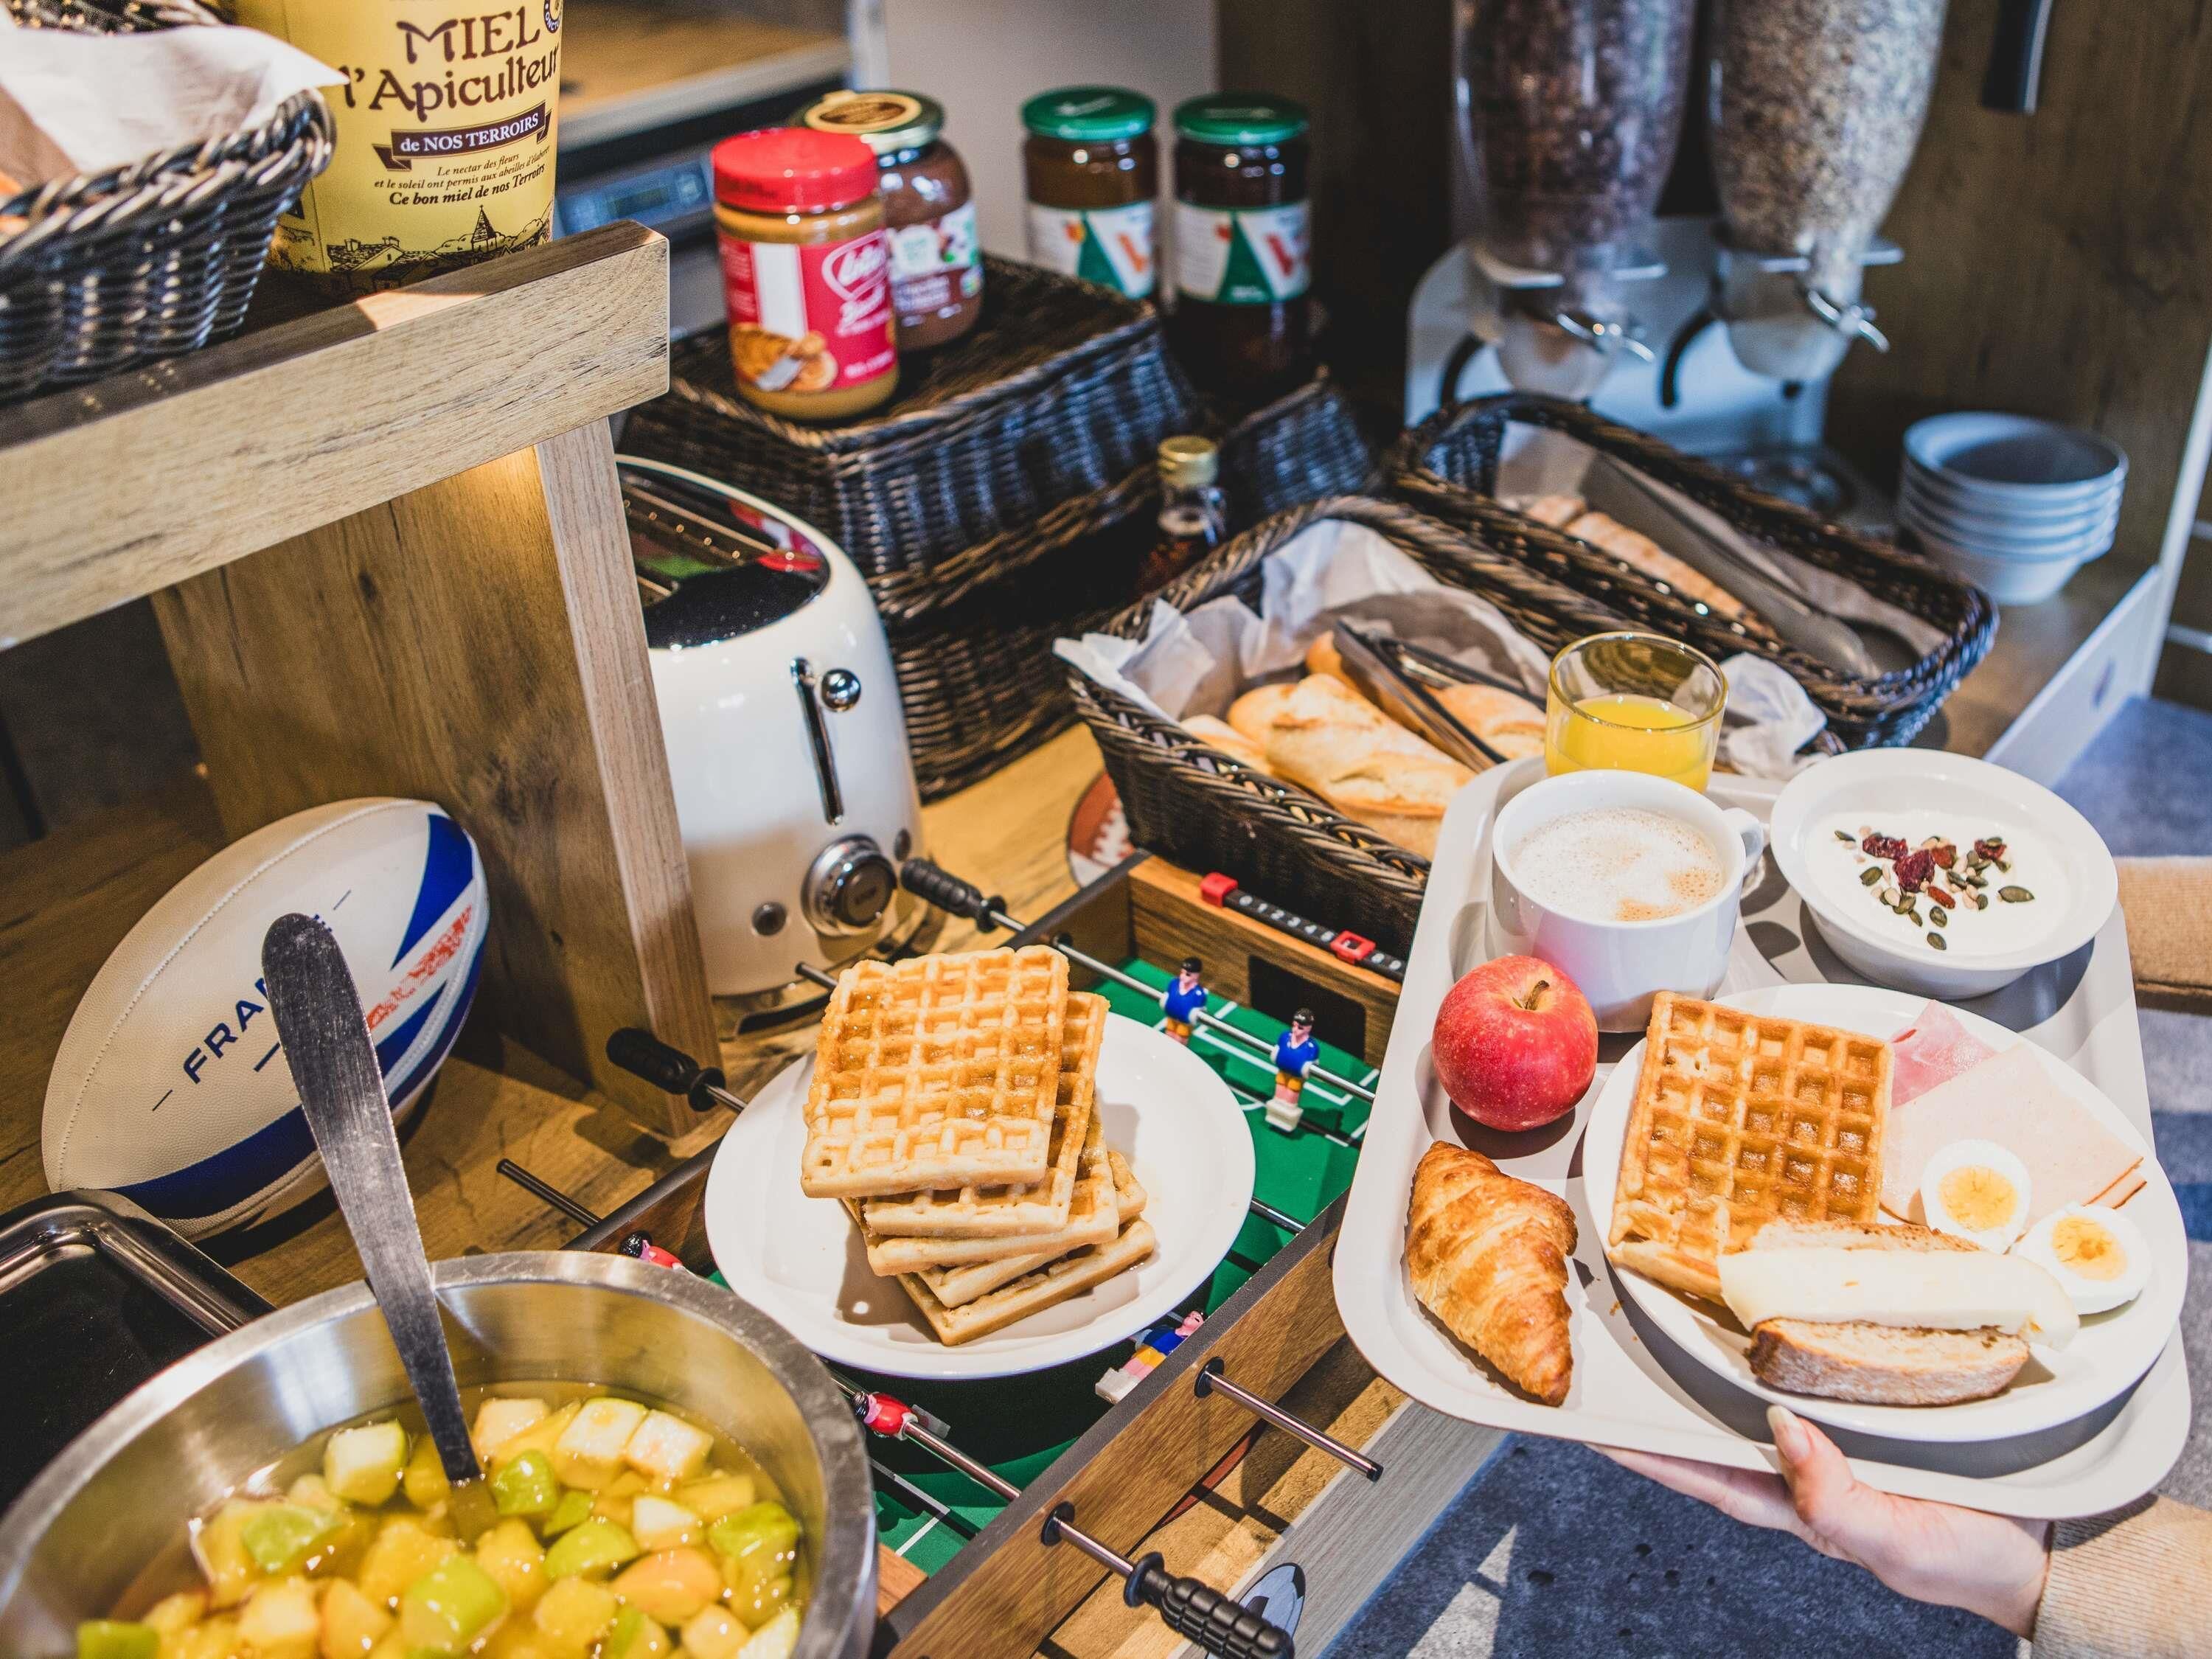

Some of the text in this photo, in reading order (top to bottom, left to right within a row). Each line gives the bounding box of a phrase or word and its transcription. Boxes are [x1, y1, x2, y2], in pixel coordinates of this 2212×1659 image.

[396, 6, 540, 64] MIEL
[338, 41, 560, 123] l'Apiculteur
[400, 113, 539, 152] de NOS TERROIRS
[374, 179, 384, 188] et
[386, 178, 397, 189] le
[398, 178, 425, 189] soleil
[427, 179, 444, 189] ont
[445, 175, 479, 191] permis
[481, 172, 497, 181] aux
[498, 161, 525, 178] abeilles
[389, 163, 545, 205] Ce bon miel de nos Terroirs
[437, 153, 520, 176] Le nectar des fleurs
